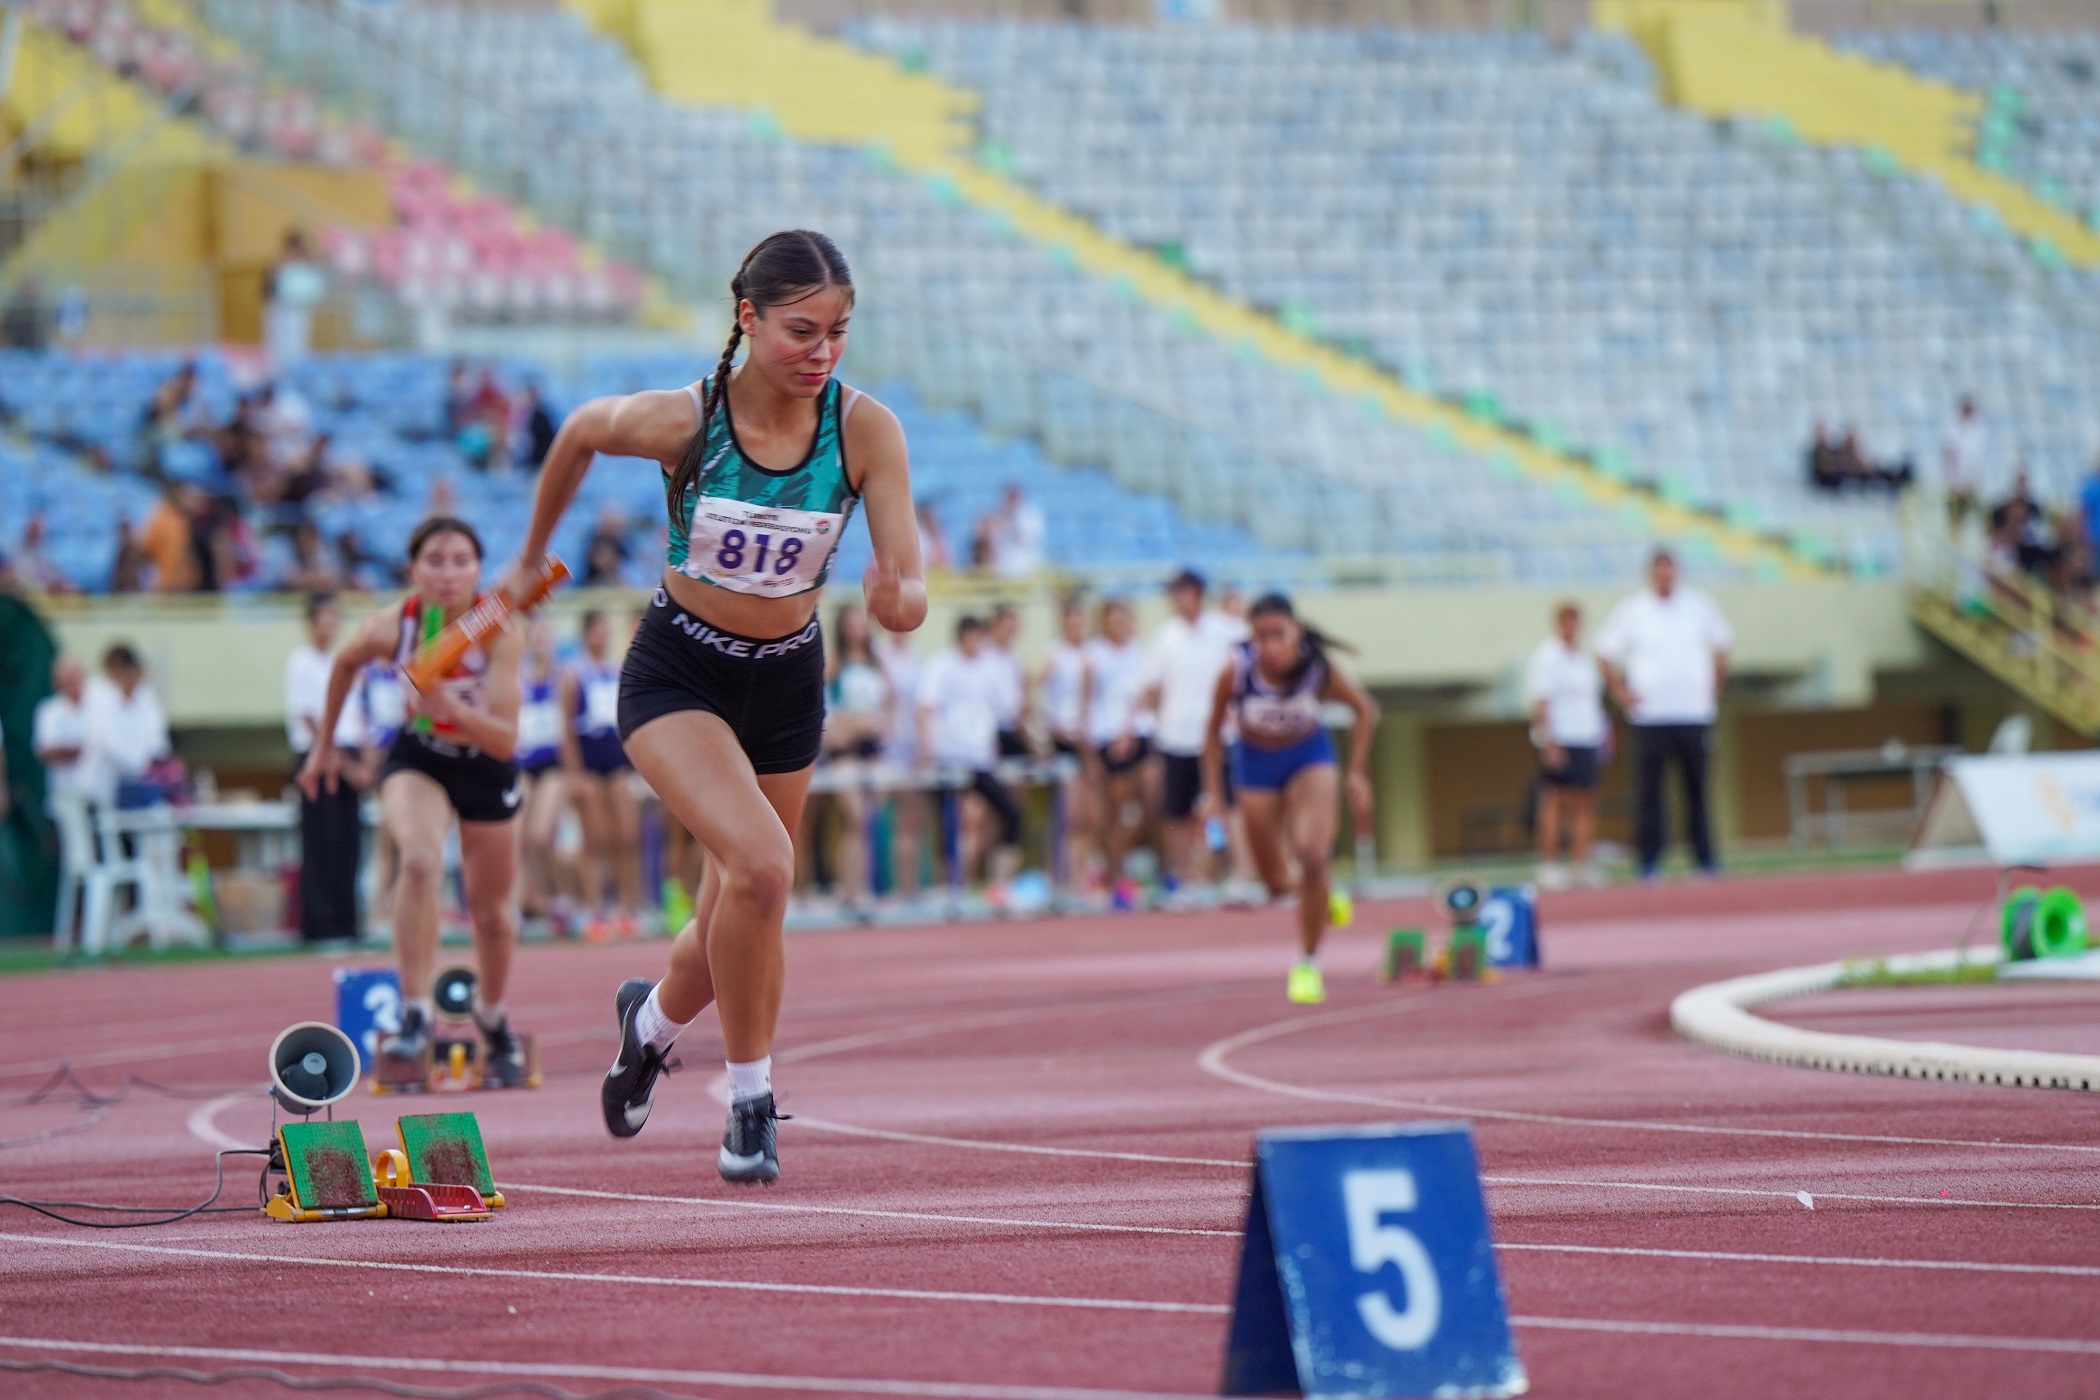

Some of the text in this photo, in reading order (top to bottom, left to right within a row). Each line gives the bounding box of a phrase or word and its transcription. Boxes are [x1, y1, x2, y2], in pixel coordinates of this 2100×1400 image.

[717, 529, 804, 575] 818
[671, 612, 819, 659] NIKE PRO
[1479, 900, 1514, 960] 2
[1342, 1168, 1443, 1350] 5
